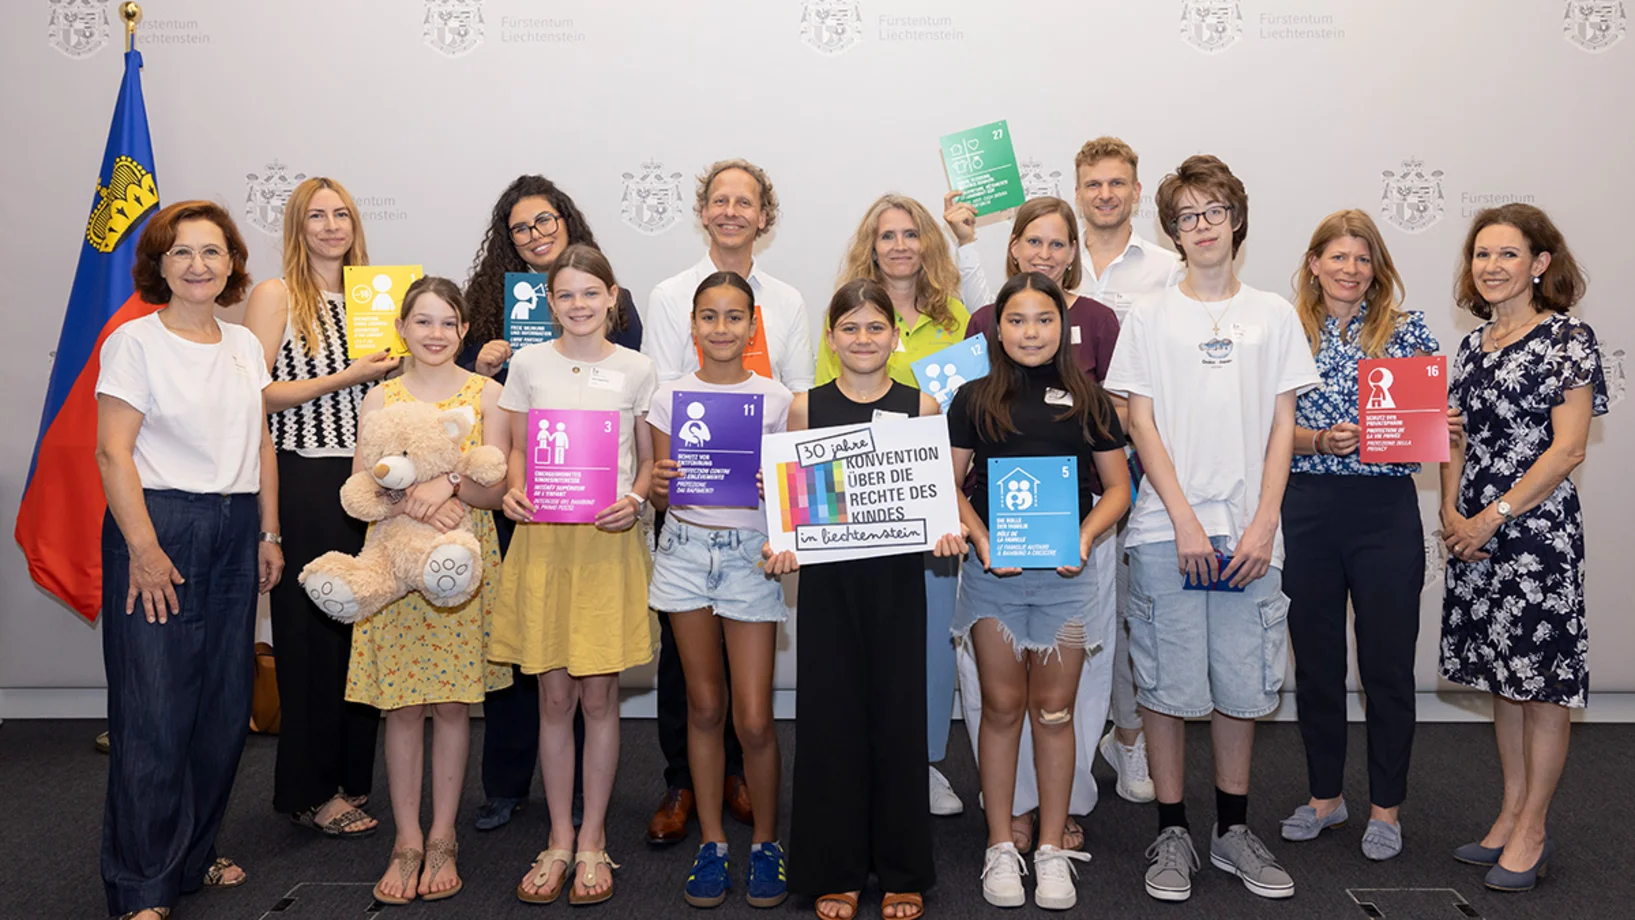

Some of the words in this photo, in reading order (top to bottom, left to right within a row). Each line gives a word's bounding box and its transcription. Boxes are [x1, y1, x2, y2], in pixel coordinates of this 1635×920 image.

[501, 15, 574, 28] Fürstentum
[879, 14, 952, 27] Fürstentum
[1260, 12, 1334, 25] Fürstentum
[138, 33, 210, 44] echtenstein
[501, 31, 586, 43] Liechtenstein
[879, 29, 964, 41] Liechtenstein
[1260, 27, 1346, 40] Liechtenstein
[992, 128, 1004, 140] 27
[970, 344, 985, 358] 12
[1426, 365, 1439, 377] 16
[743, 404, 755, 416] 11
[604, 420, 612, 433] 3
[803, 442, 827, 460] 30
[830, 438, 870, 460] jahre
[846, 446, 941, 470] KONVENTION
[847, 470, 887, 489] ÜBER
[891, 467, 915, 484] DIE
[1062, 466, 1070, 478] 5
[850, 489, 905, 508] RECHTE
[910, 483, 939, 501] DES
[852, 506, 906, 523] KINDES
[801, 531, 818, 544] in
[821, 525, 923, 546] liechtenstein
